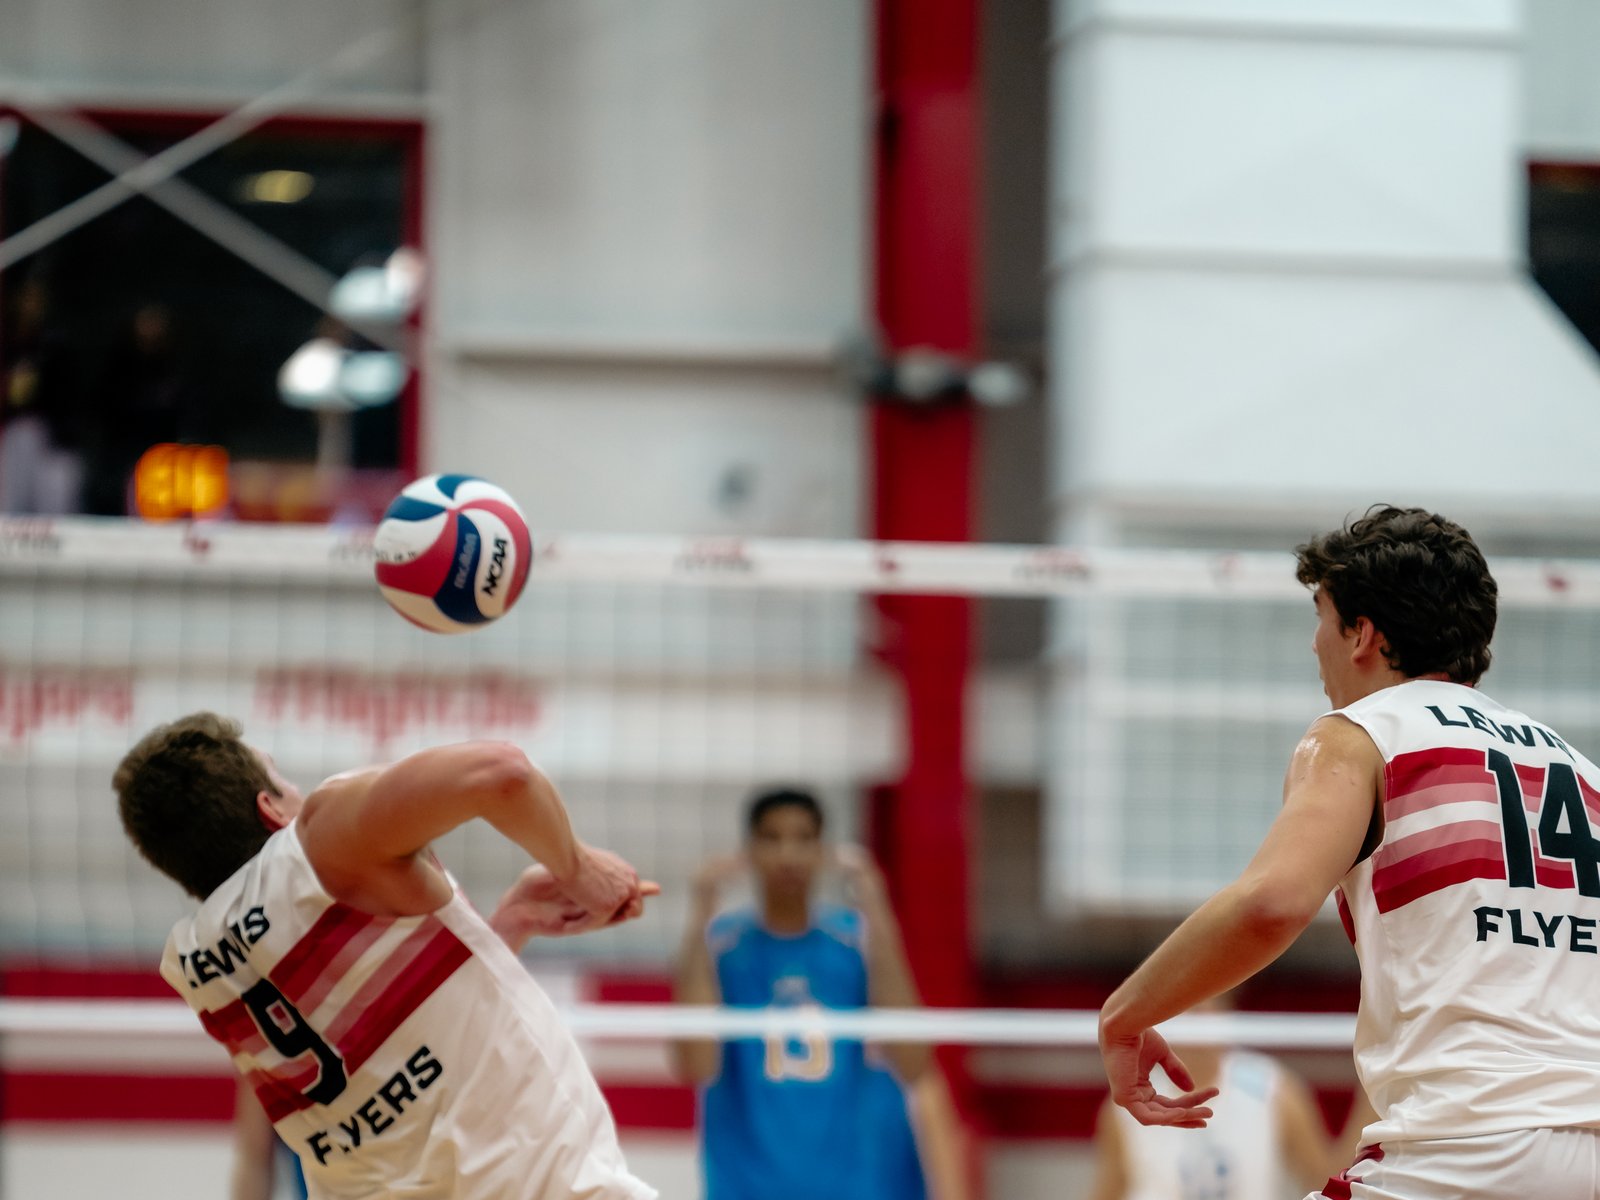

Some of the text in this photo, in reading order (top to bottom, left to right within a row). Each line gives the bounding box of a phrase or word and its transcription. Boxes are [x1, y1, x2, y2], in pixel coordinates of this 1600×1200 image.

[481, 534, 508, 596] NCAA
[1488, 747, 1600, 898] 14
[1473, 906, 1600, 954] FLYE
[241, 977, 347, 1106] 9
[306, 1045, 443, 1167] FYERS
